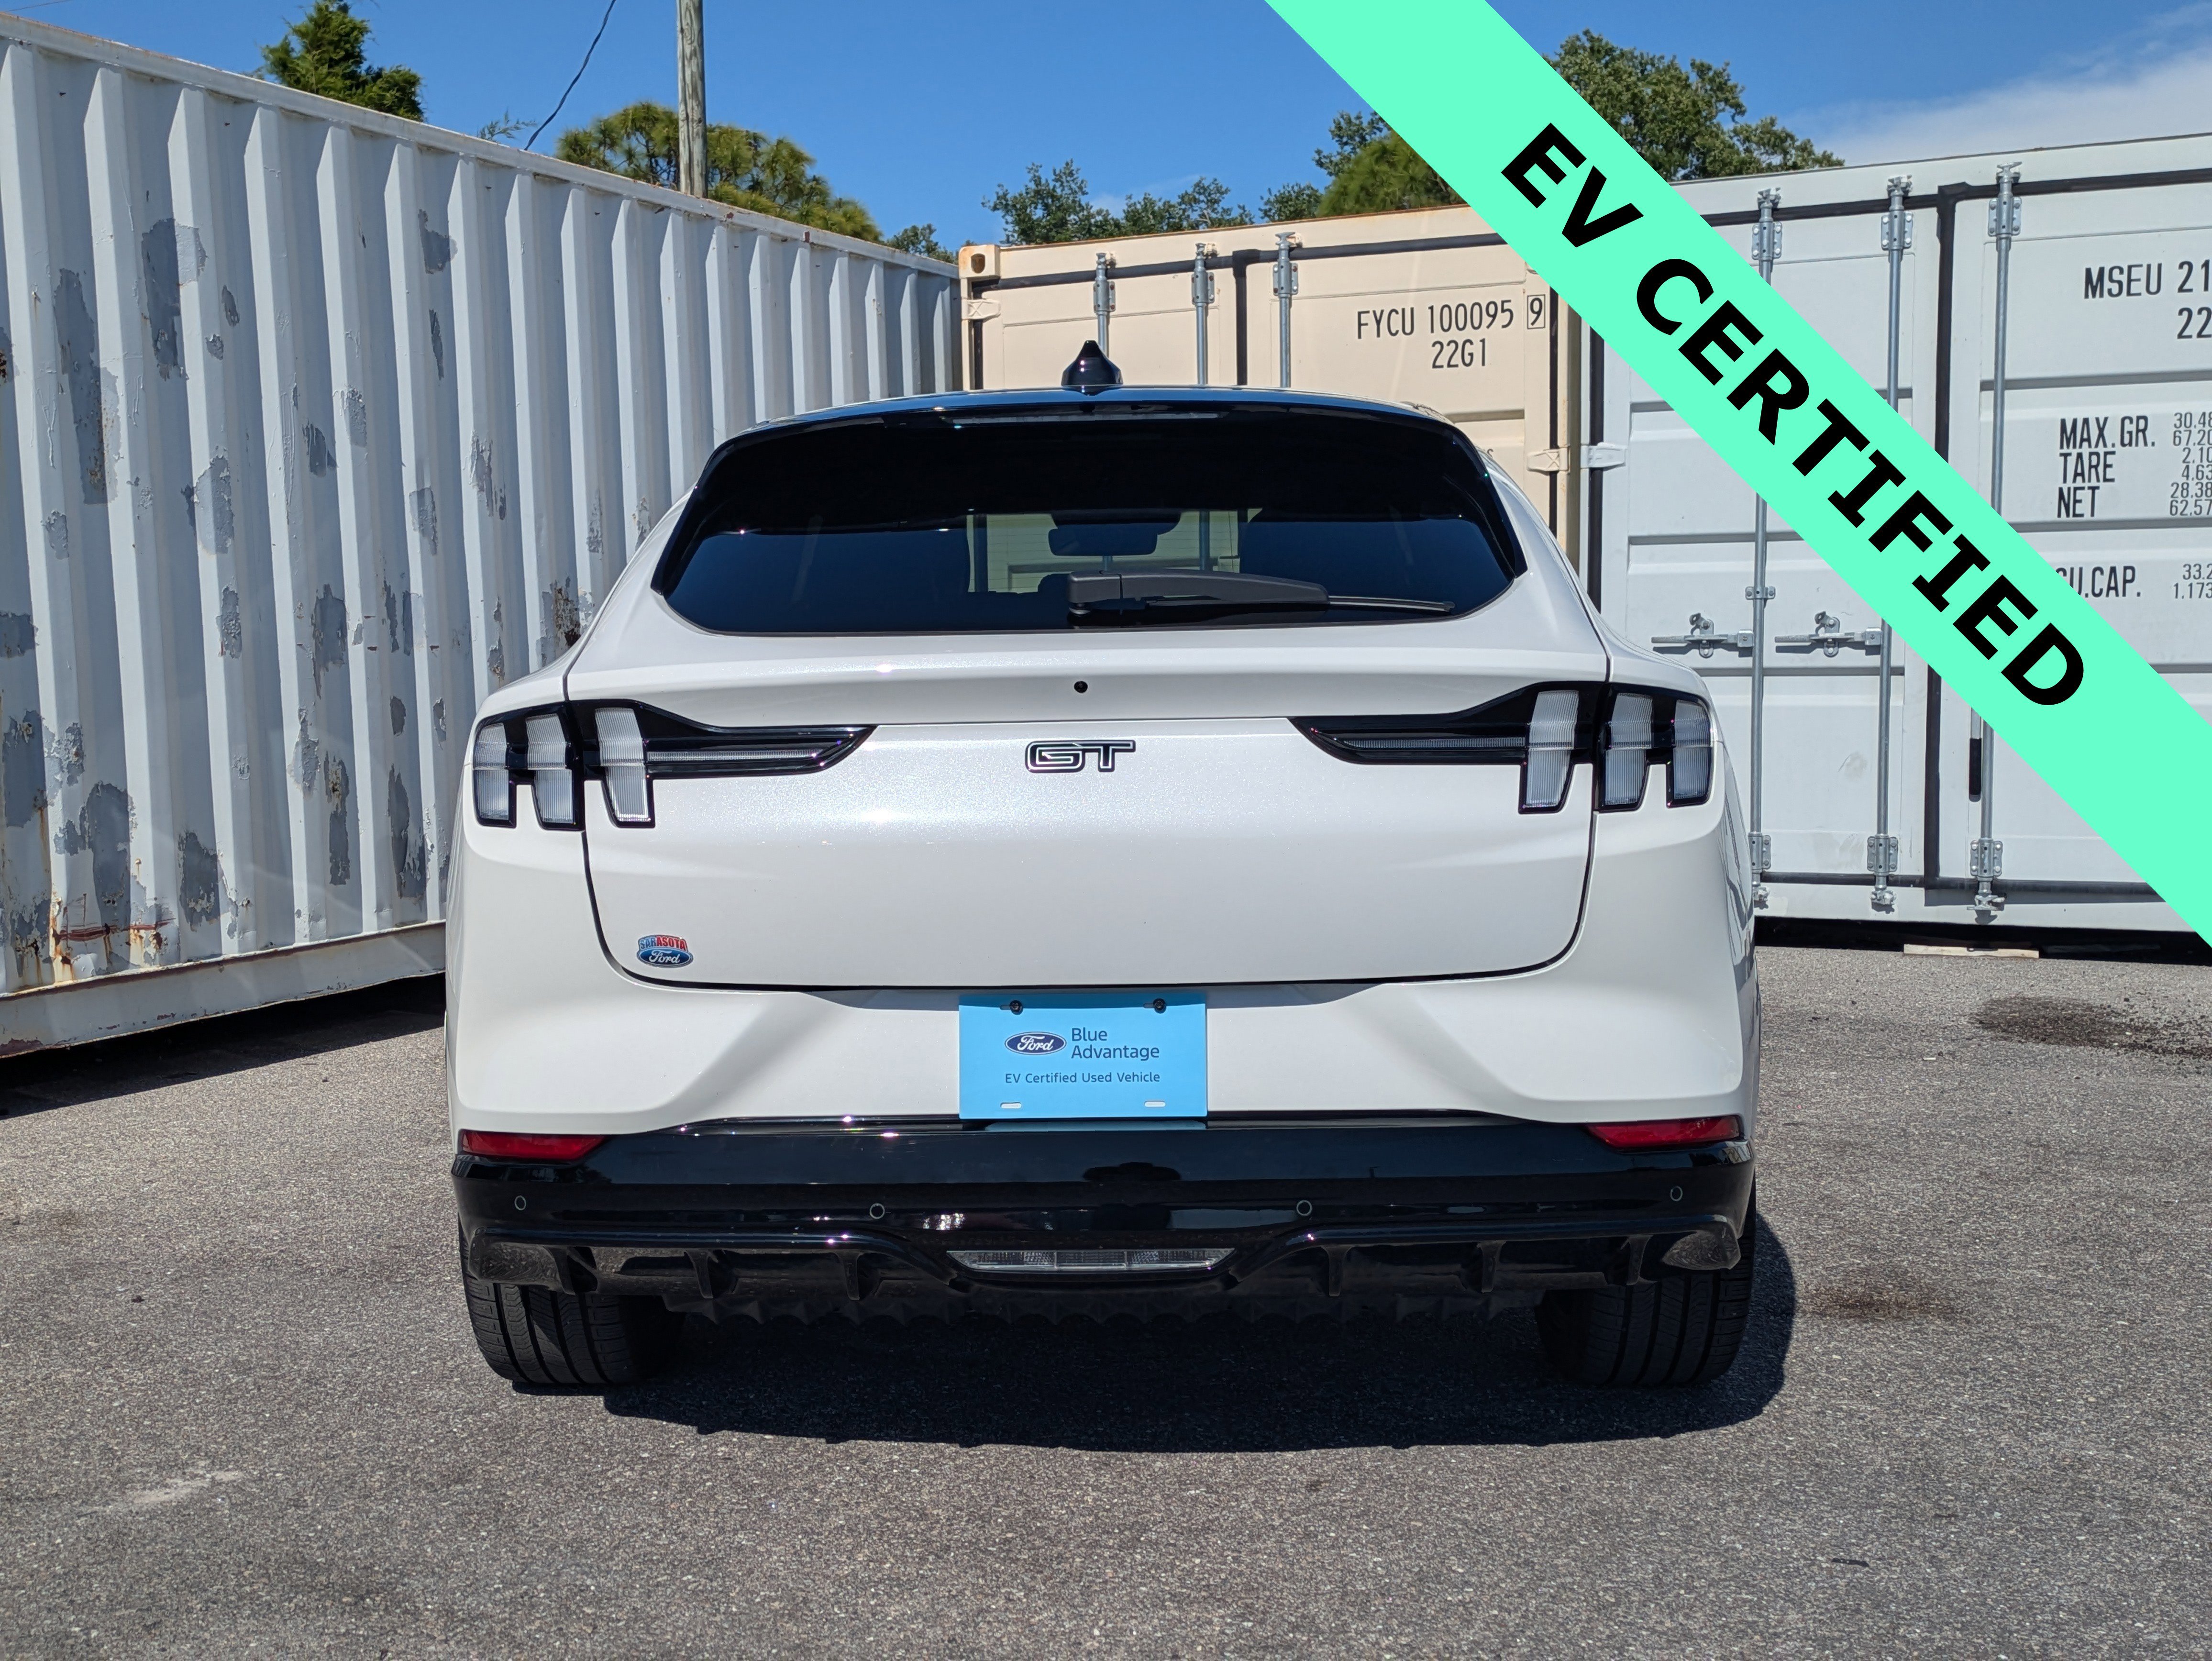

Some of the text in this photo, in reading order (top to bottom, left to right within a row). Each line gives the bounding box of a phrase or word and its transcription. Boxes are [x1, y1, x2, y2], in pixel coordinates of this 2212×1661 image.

[2084, 259, 2211, 299] MSEU 21
[1357, 297, 1542, 339] FYCU 100095 9
[2177, 307, 2212, 339] 22
[1431, 338, 1486, 369] 22G1
[2059, 451, 2116, 484] TARE
[2057, 485, 2101, 519] NET
[1025, 739, 1136, 774] GT
[639, 935, 686, 951] SARASOTA
[649, 950, 681, 963] Ford
[1017, 1035, 1054, 1052] Ford
[1071, 1027, 1108, 1042] Blue
[1071, 1044, 1160, 1062] Advantage
[1005, 1072, 1161, 1084] EV Certified Used Vehicle
